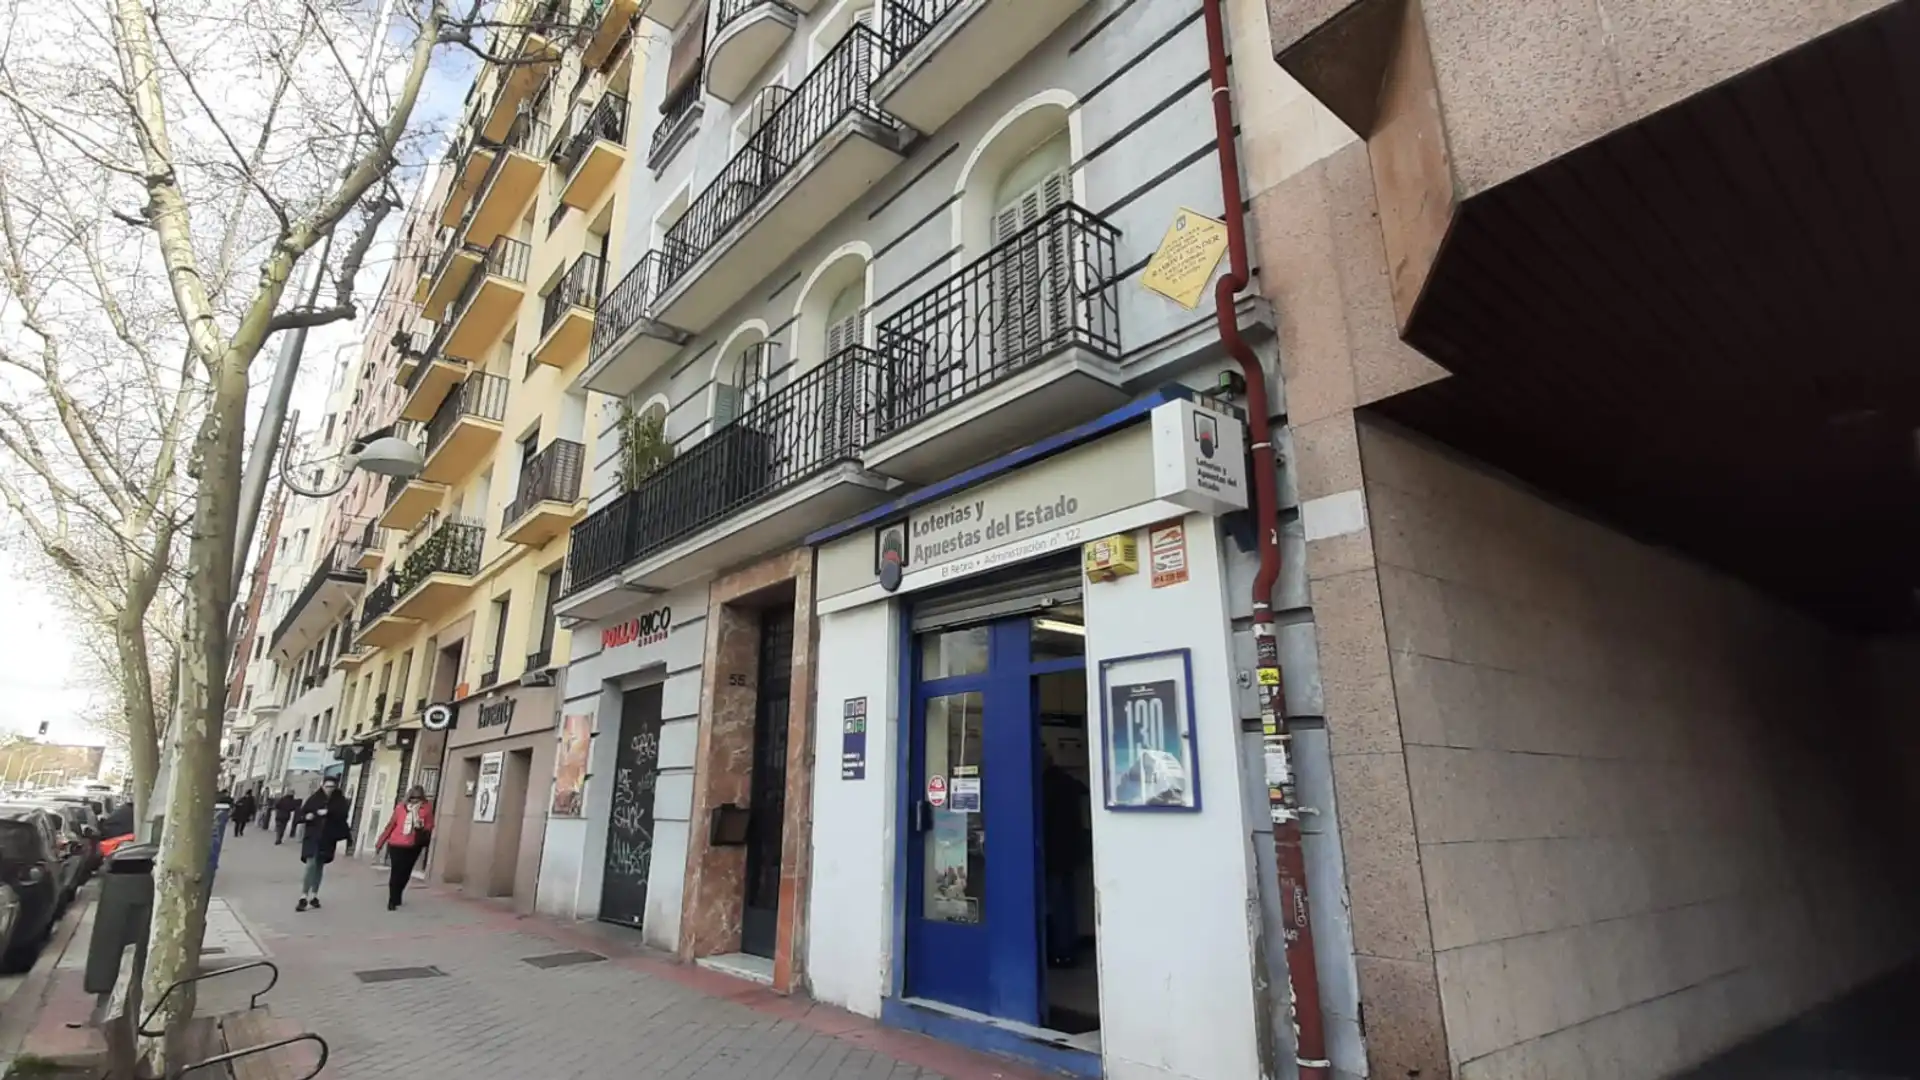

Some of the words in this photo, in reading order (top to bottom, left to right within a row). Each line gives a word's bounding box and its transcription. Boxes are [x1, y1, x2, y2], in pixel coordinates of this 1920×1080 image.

[912, 529, 982, 565] Apuestas
[985, 514, 1010, 541] del
[1015, 495, 1079, 531] Estado
[913, 505, 972, 538] Loterías
[974, 500, 985, 521] y
[1065, 527, 1081, 542] 122
[602, 618, 639, 649] POLLO
[639, 606, 671, 637] RICO
[1123, 697, 1165, 767] 130
